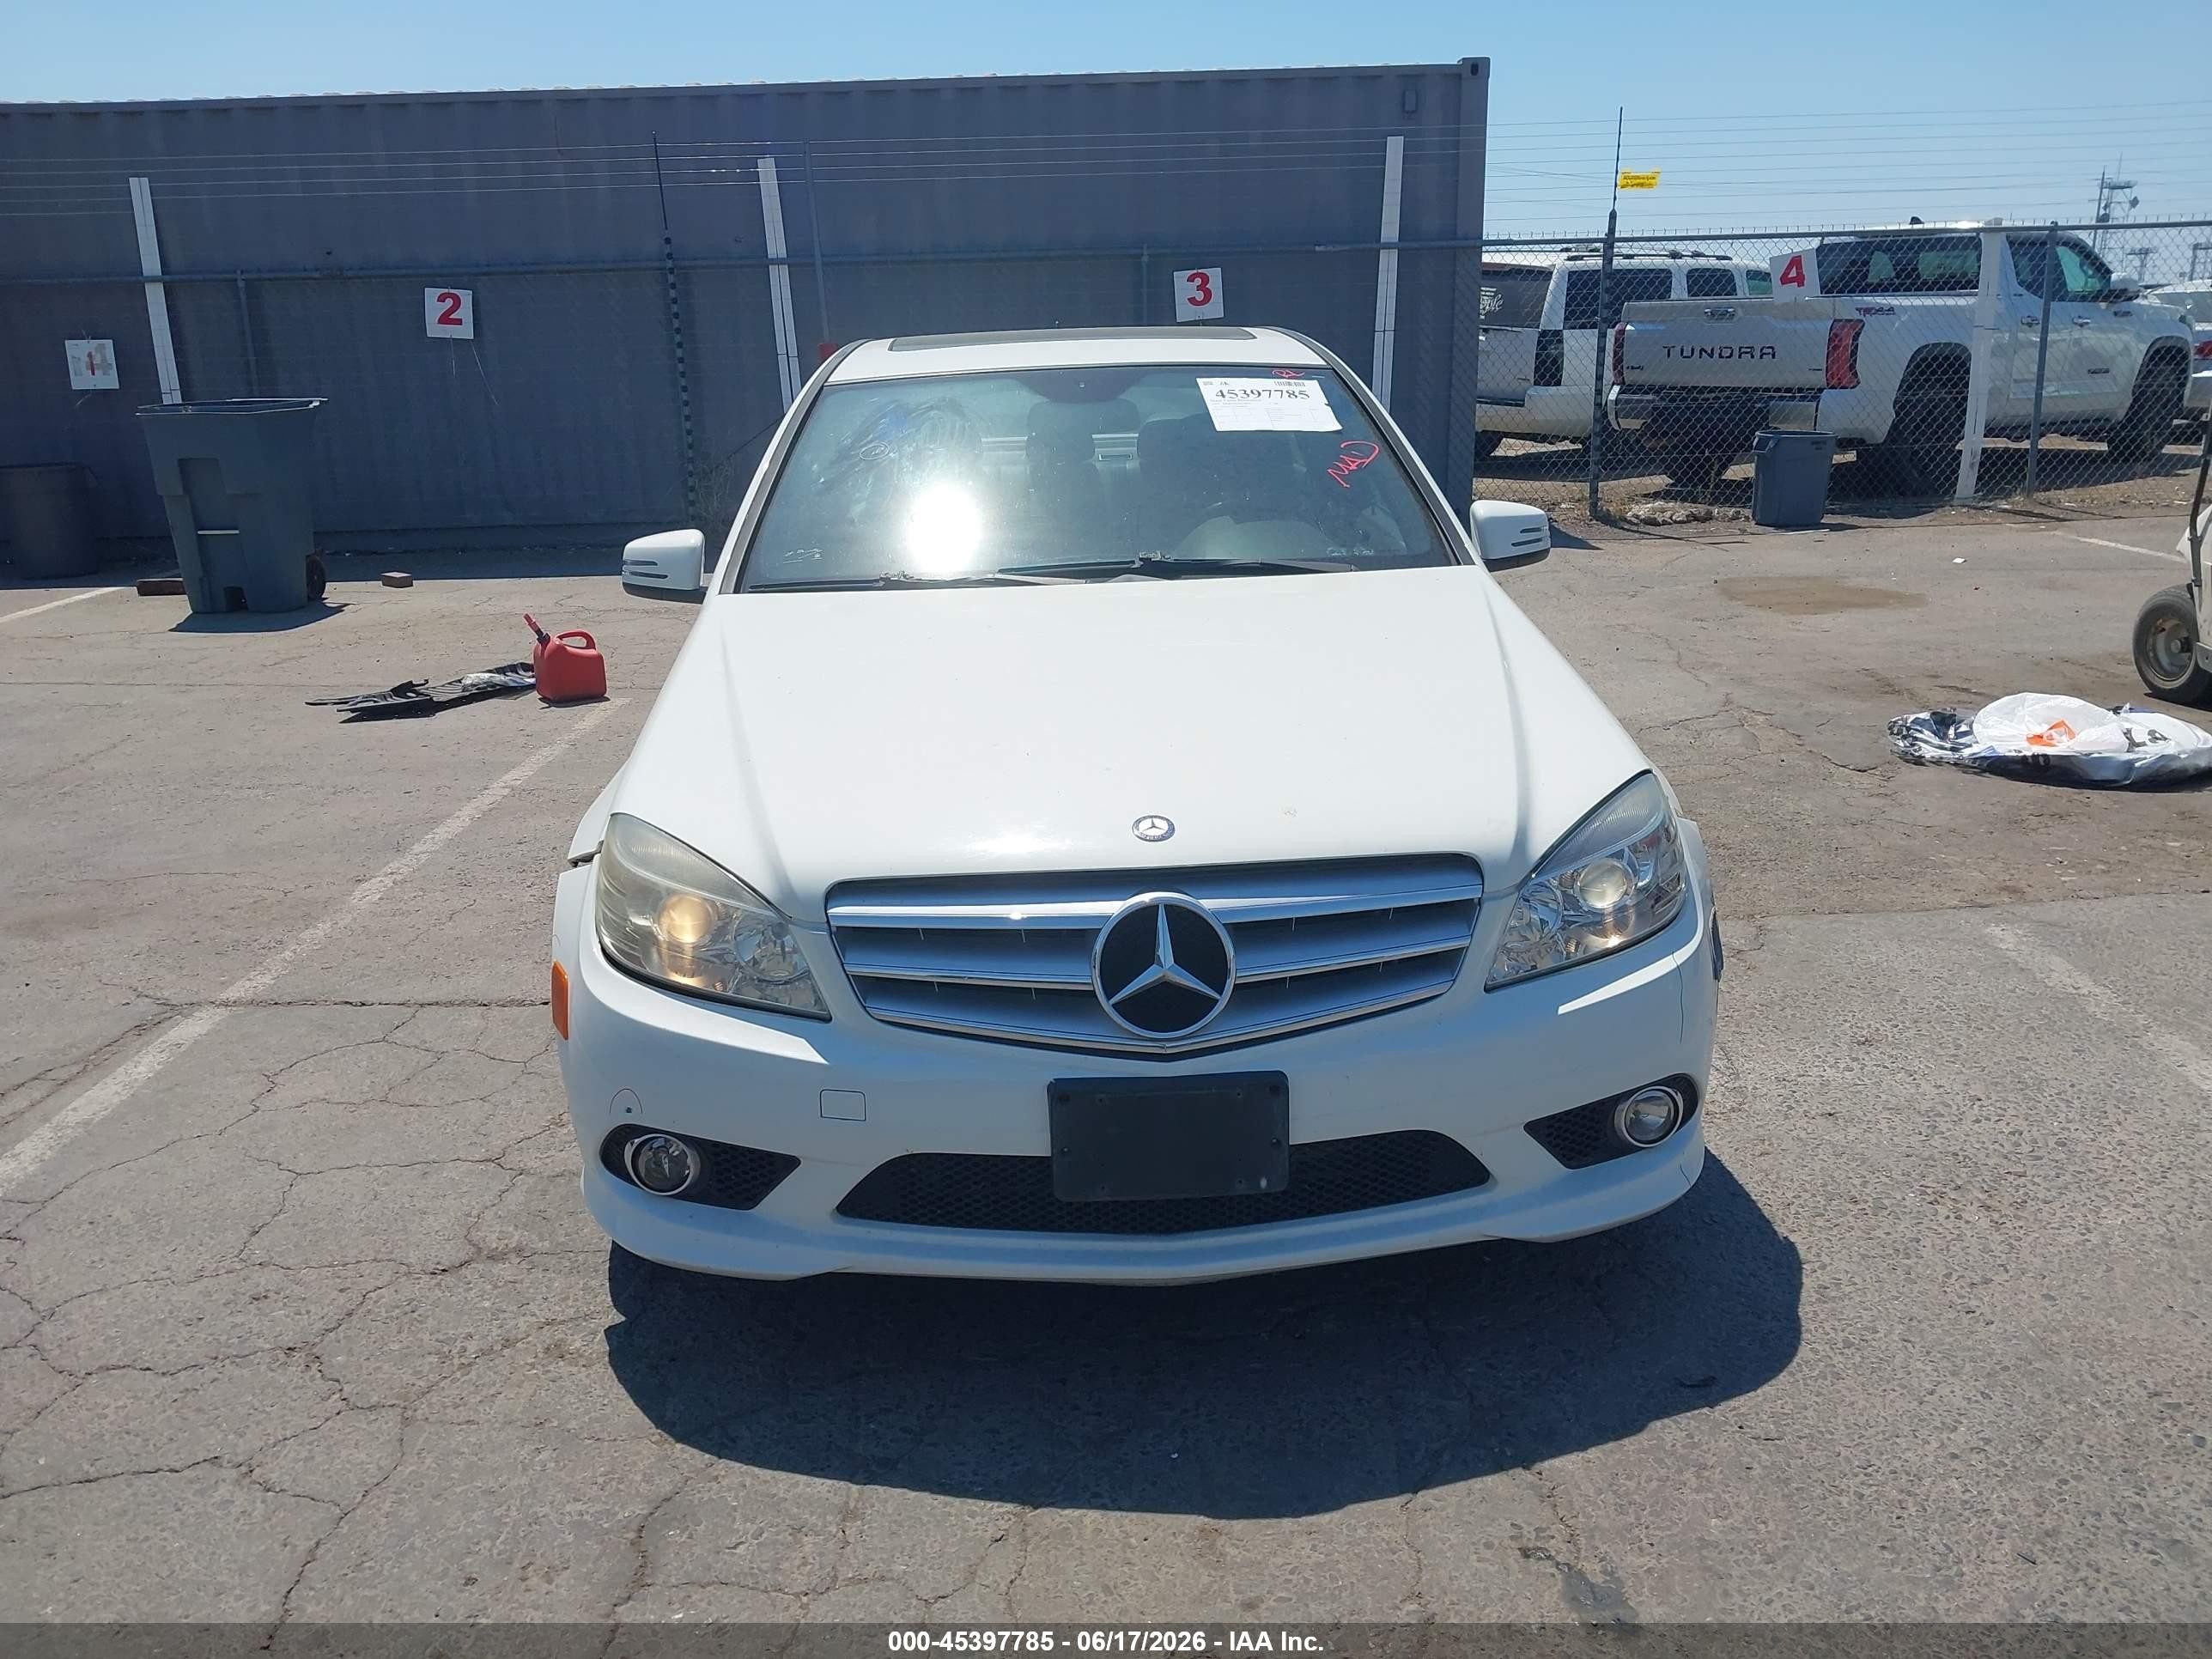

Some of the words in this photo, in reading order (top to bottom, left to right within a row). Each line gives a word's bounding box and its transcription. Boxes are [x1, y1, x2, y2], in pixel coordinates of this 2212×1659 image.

[1780, 254, 1806, 288] 4
[1187, 271, 1212, 307] 3
[436, 292, 463, 325] 2
[1662, 345, 1777, 360] TUNDRA
[1215, 388, 1311, 400] 45397785
